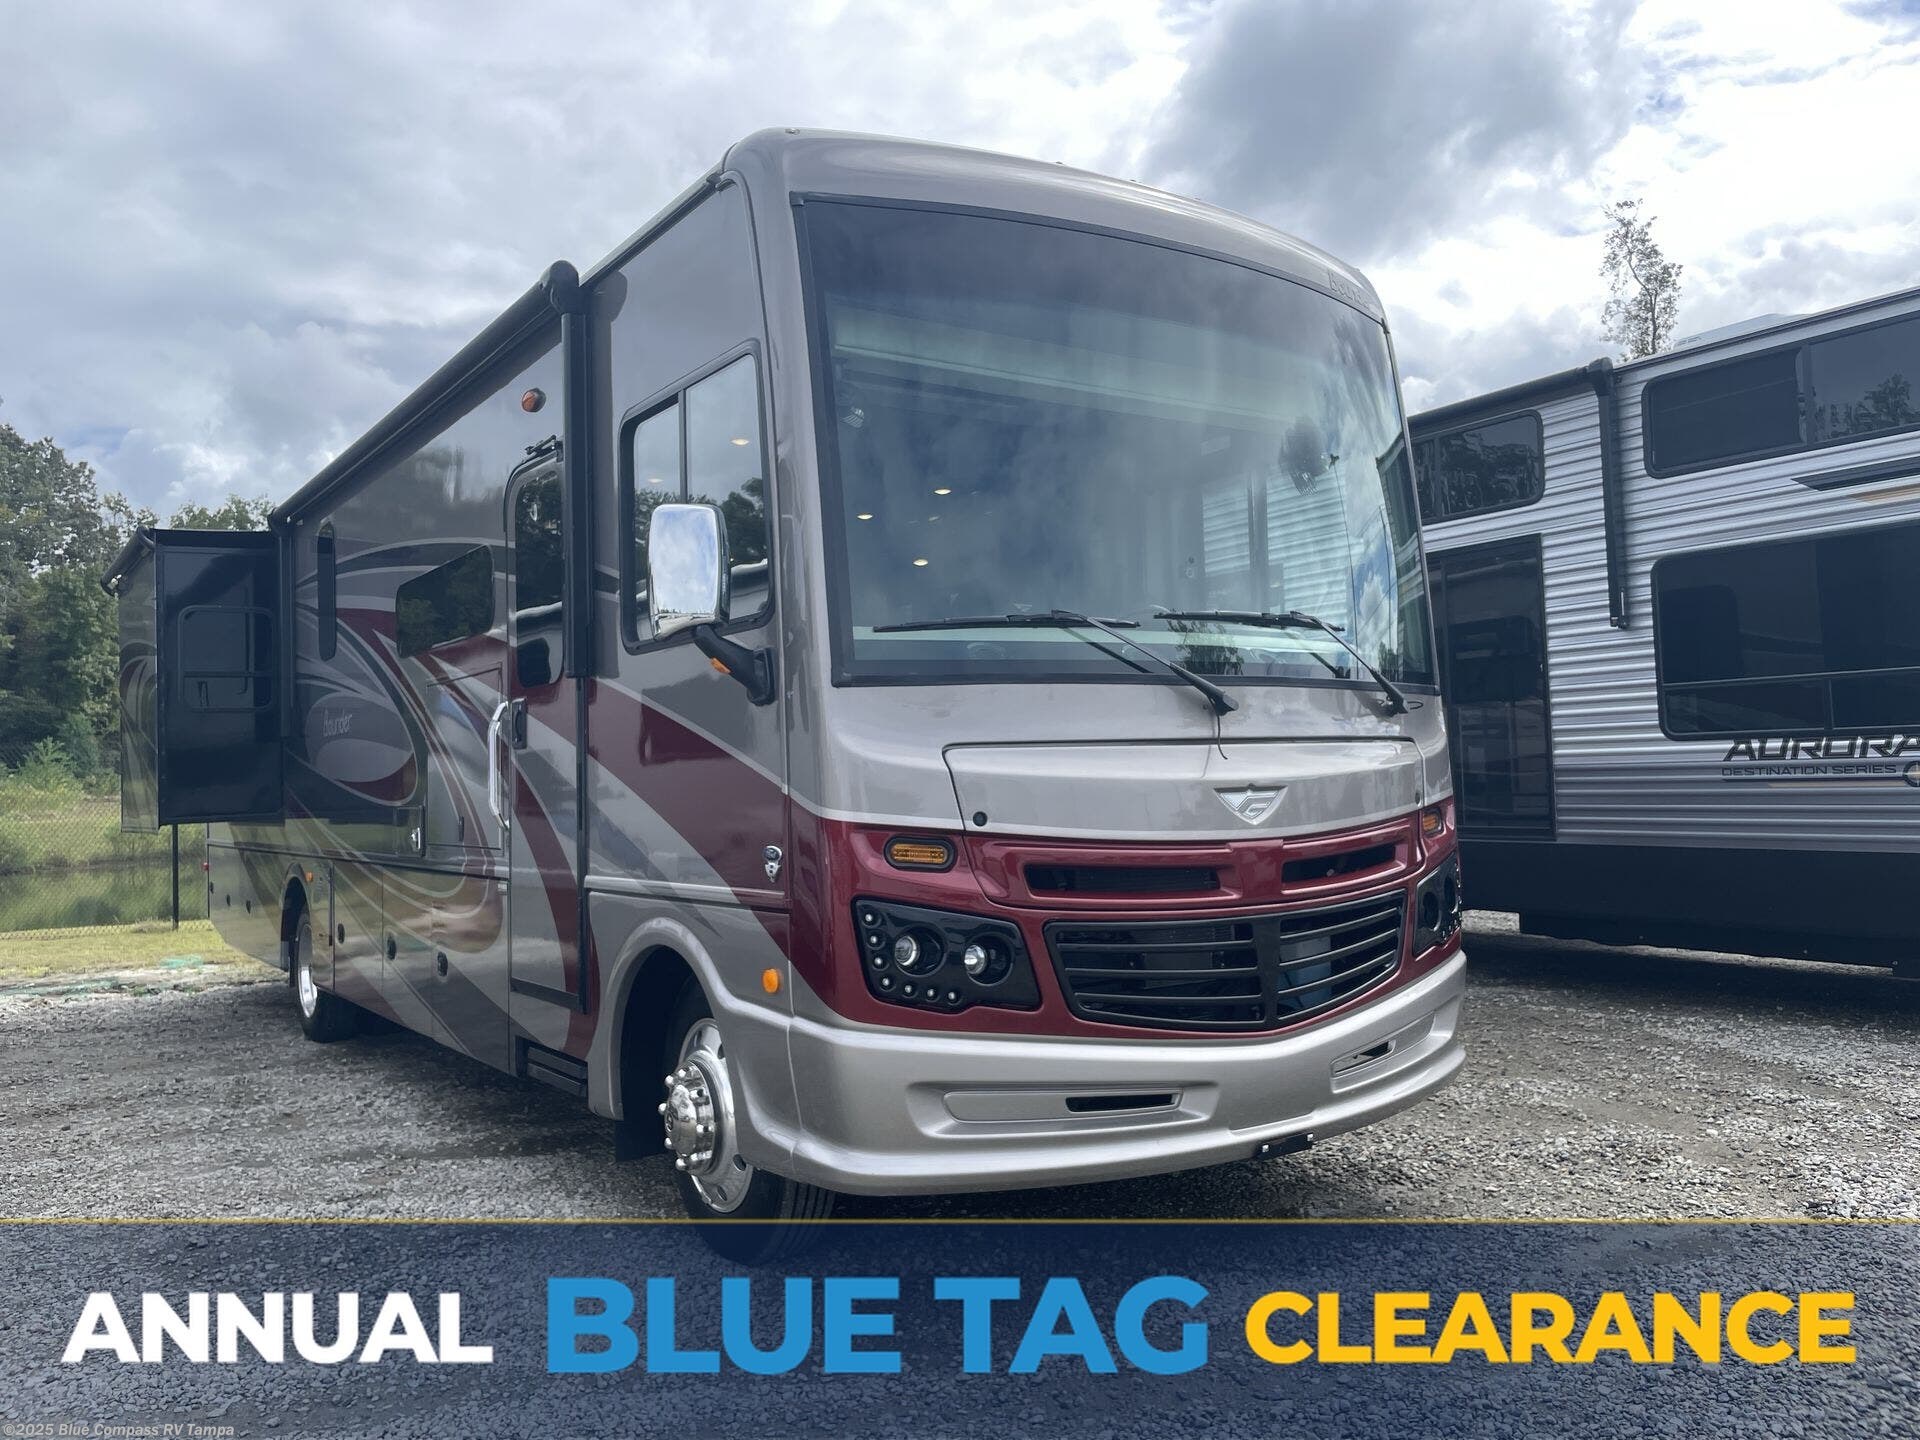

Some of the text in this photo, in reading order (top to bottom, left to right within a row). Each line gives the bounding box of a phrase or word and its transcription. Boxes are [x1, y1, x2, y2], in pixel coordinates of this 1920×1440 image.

[1723, 735, 1920, 761] AURORA
[1721, 764, 1897, 777] DESTINATION SERIES
